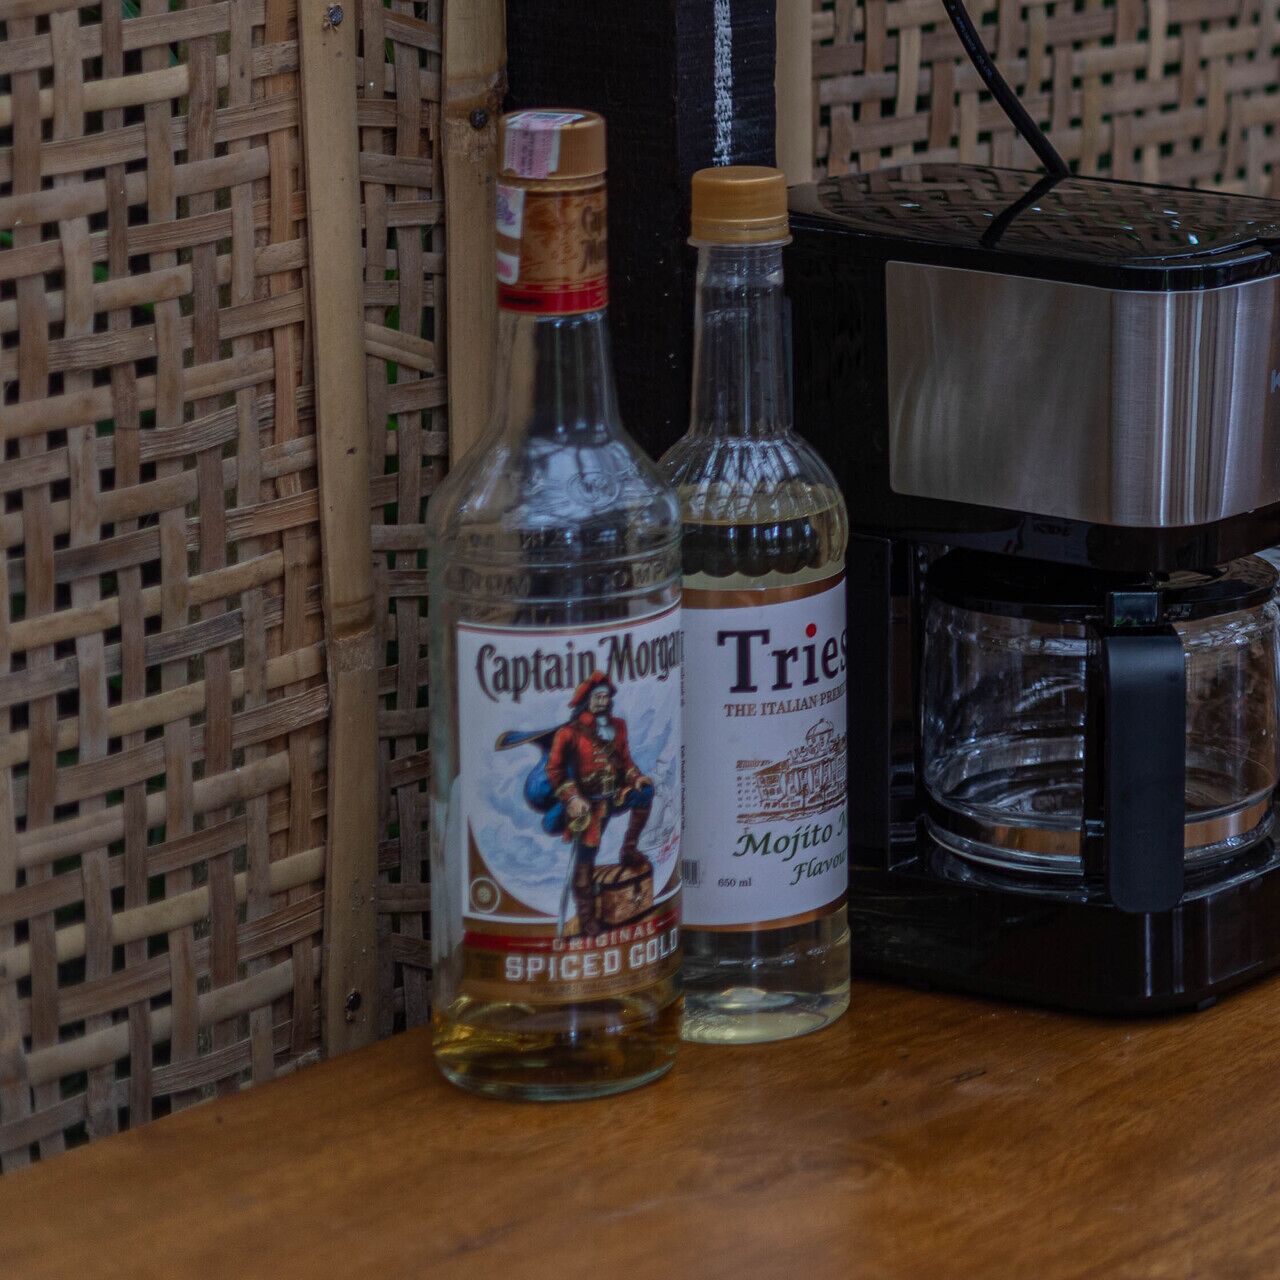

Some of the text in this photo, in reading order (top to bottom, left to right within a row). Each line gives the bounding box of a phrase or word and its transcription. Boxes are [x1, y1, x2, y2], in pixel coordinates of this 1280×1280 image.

[475, 640, 597, 704] Captain
[723, 703, 757, 718] THE
[760, 694, 818, 716] ITALIAN
[732, 823, 833, 862] Mojito
[717, 877, 752, 888] 650 ml
[552, 922, 657, 952] ORIGINAL
[504, 948, 622, 983] SPICED
[629, 926, 680, 970] GOLD
